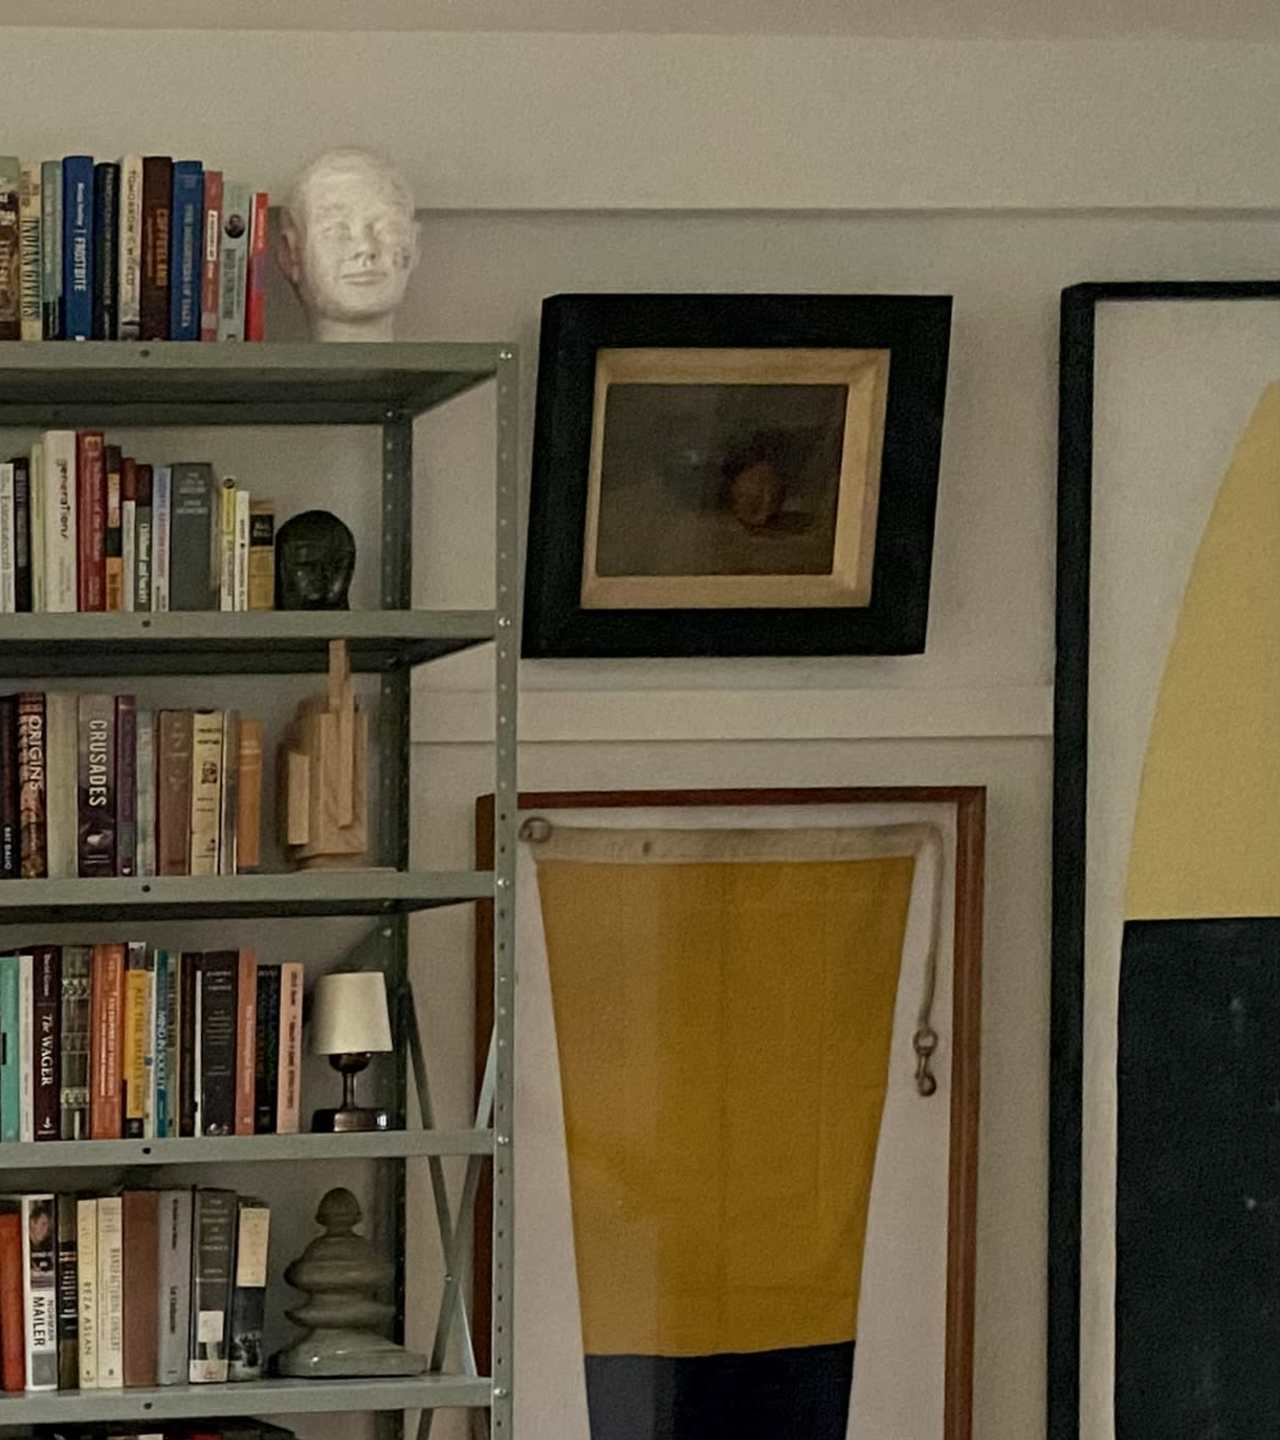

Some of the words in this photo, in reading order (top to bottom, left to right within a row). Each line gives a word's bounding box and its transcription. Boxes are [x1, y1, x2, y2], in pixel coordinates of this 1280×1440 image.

[21, 218, 41, 269] INDIAN
[73, 236, 87, 292] FROSTBITE
[22, 271, 41, 319] GIVERS
[54, 459, 71, 539] generations
[0, 496, 14, 571] Extrastatecraft
[138, 562, 150, 575] and
[138, 576, 150, 604] Society
[28, 714, 42, 791] ORIGINS
[88, 719, 108, 807] CRUSADES
[41, 1013, 54, 1033] The
[155, 1011, 166, 1038] MIND
[155, 1039, 166, 1049] IN
[41, 1035, 54, 1086] WAGER
[155, 1051, 166, 1089] SOCIETY
[82, 1280, 92, 1311] REZA
[32, 1296, 47, 1347] MAILER
[47, 1299, 56, 1342] NORMAN
[83, 1317, 94, 1356] ASLAN
